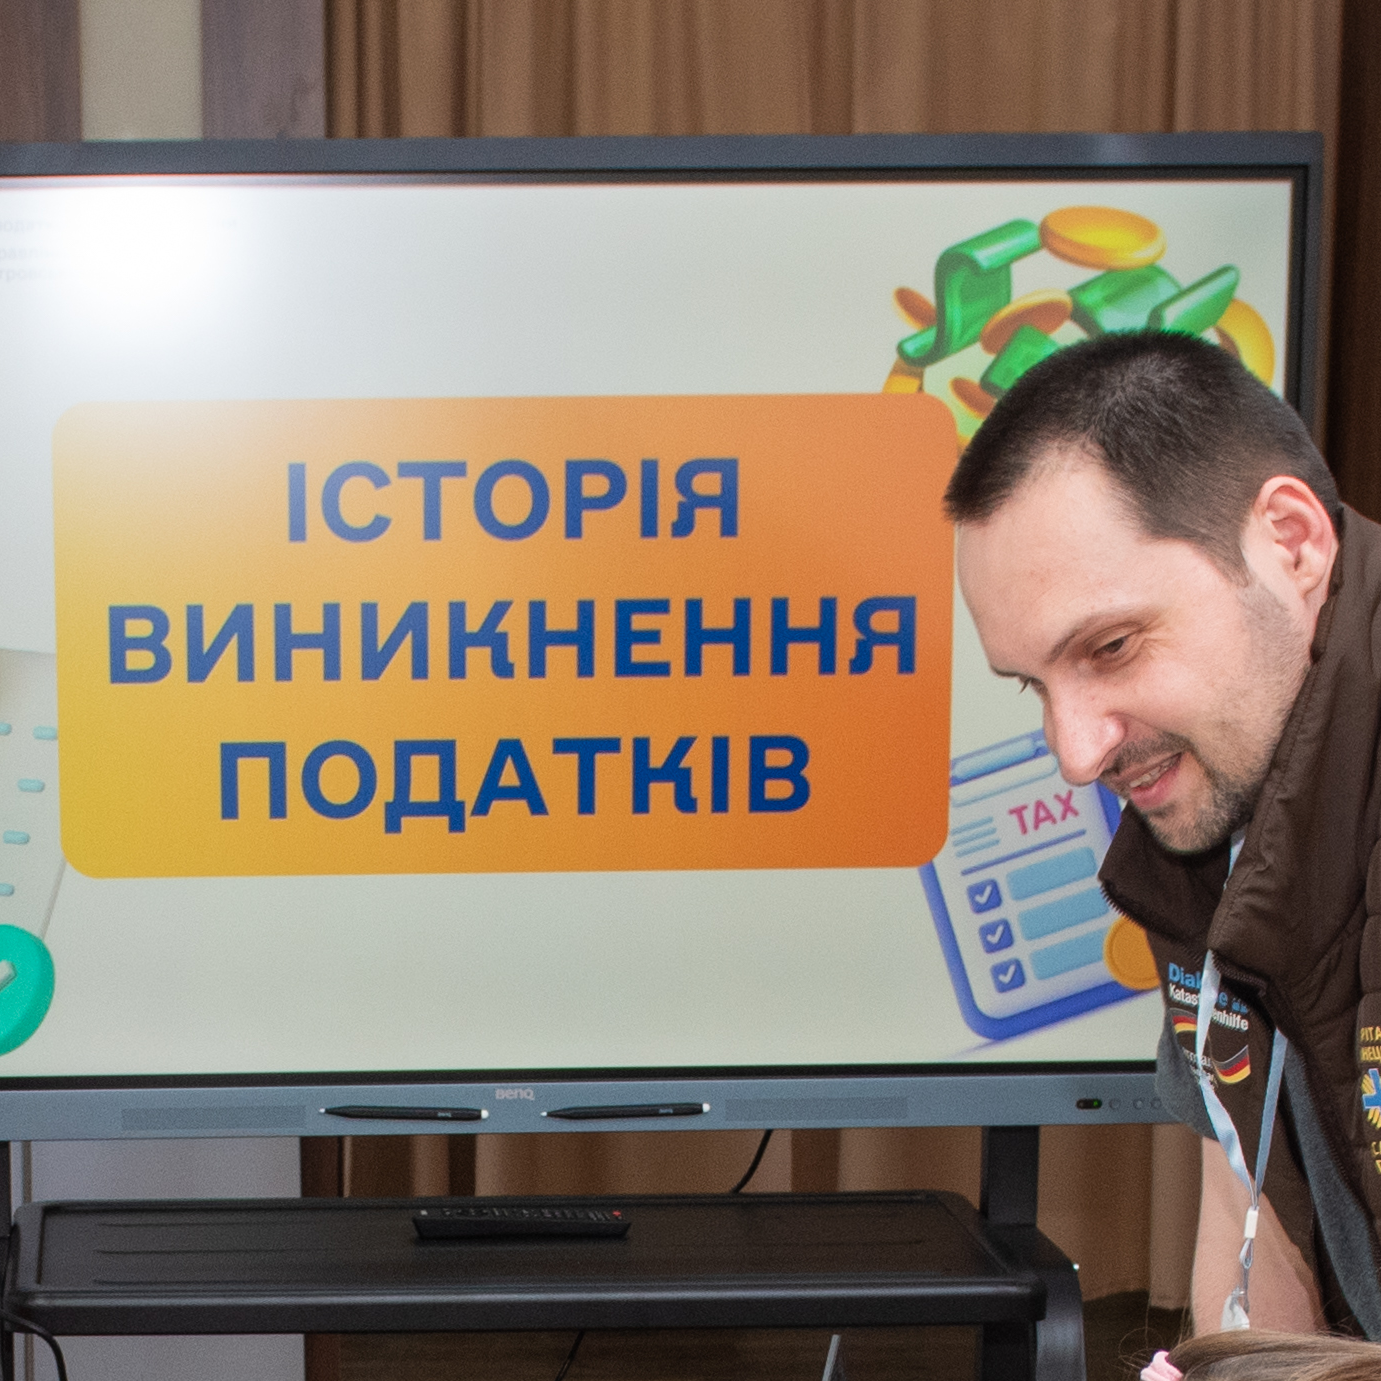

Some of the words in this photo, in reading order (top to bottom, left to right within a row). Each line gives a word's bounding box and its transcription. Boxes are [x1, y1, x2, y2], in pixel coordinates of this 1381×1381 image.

[287, 457, 741, 543] ІСТОРІЯ
[107, 595, 918, 685] ВИНИКНЕННЯ
[220, 735, 812, 834] ПОДАТКІВ
[1008, 789, 1080, 835] TAX
